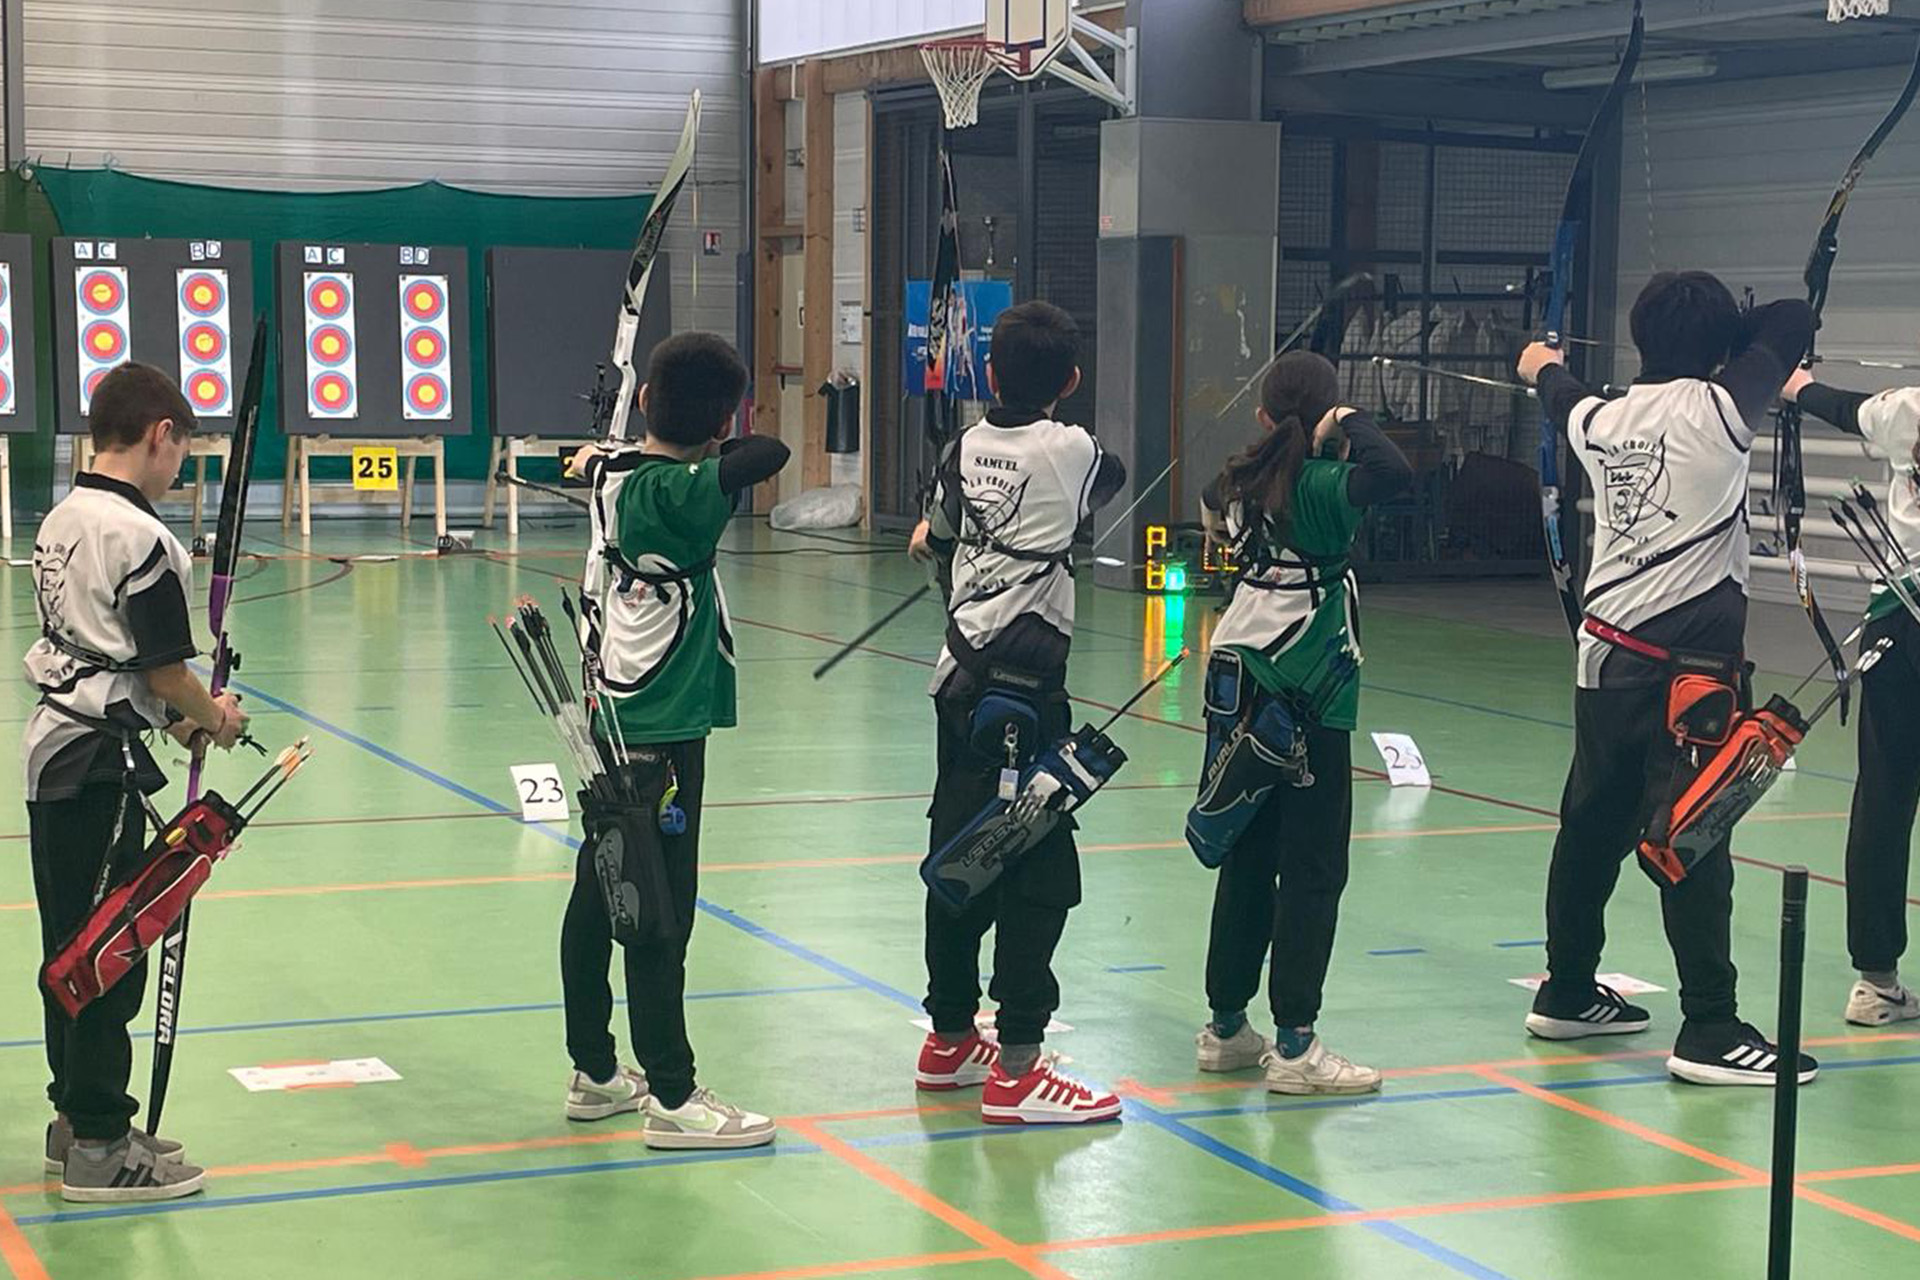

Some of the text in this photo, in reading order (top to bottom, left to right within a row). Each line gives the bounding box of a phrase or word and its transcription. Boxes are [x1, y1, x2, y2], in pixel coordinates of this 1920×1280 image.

[358, 456, 393, 479] 25
[974, 456, 1019, 472] SAMUEL
[1383, 745, 1422, 770] 25
[519, 777, 564, 804] 23
[157, 931, 184, 1045] VELORA
